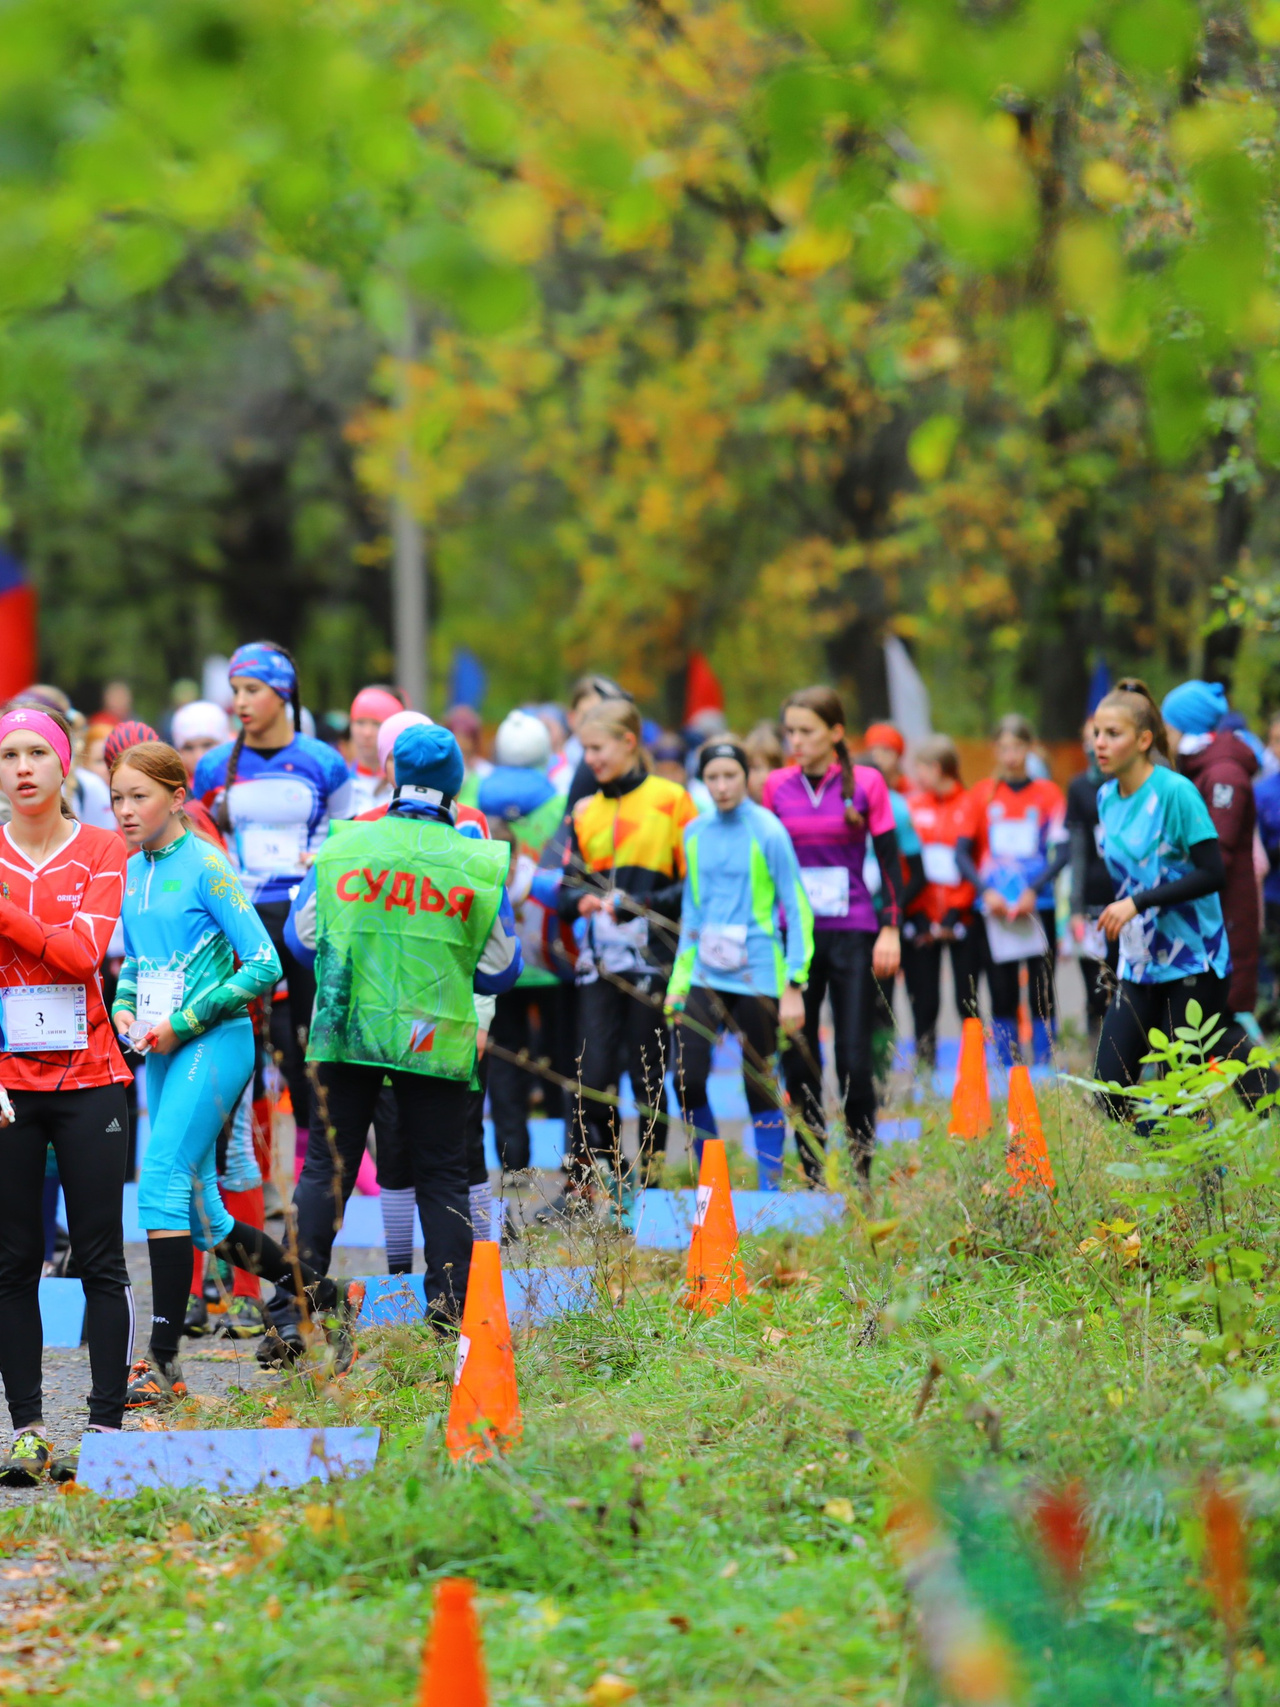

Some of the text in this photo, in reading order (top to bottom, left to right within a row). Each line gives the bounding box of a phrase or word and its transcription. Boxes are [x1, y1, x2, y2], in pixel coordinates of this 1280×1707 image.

[335, 867, 475, 923] СУДЬЯ
[139, 993, 151, 1007] 14
[35, 1011, 45, 1027] 3
